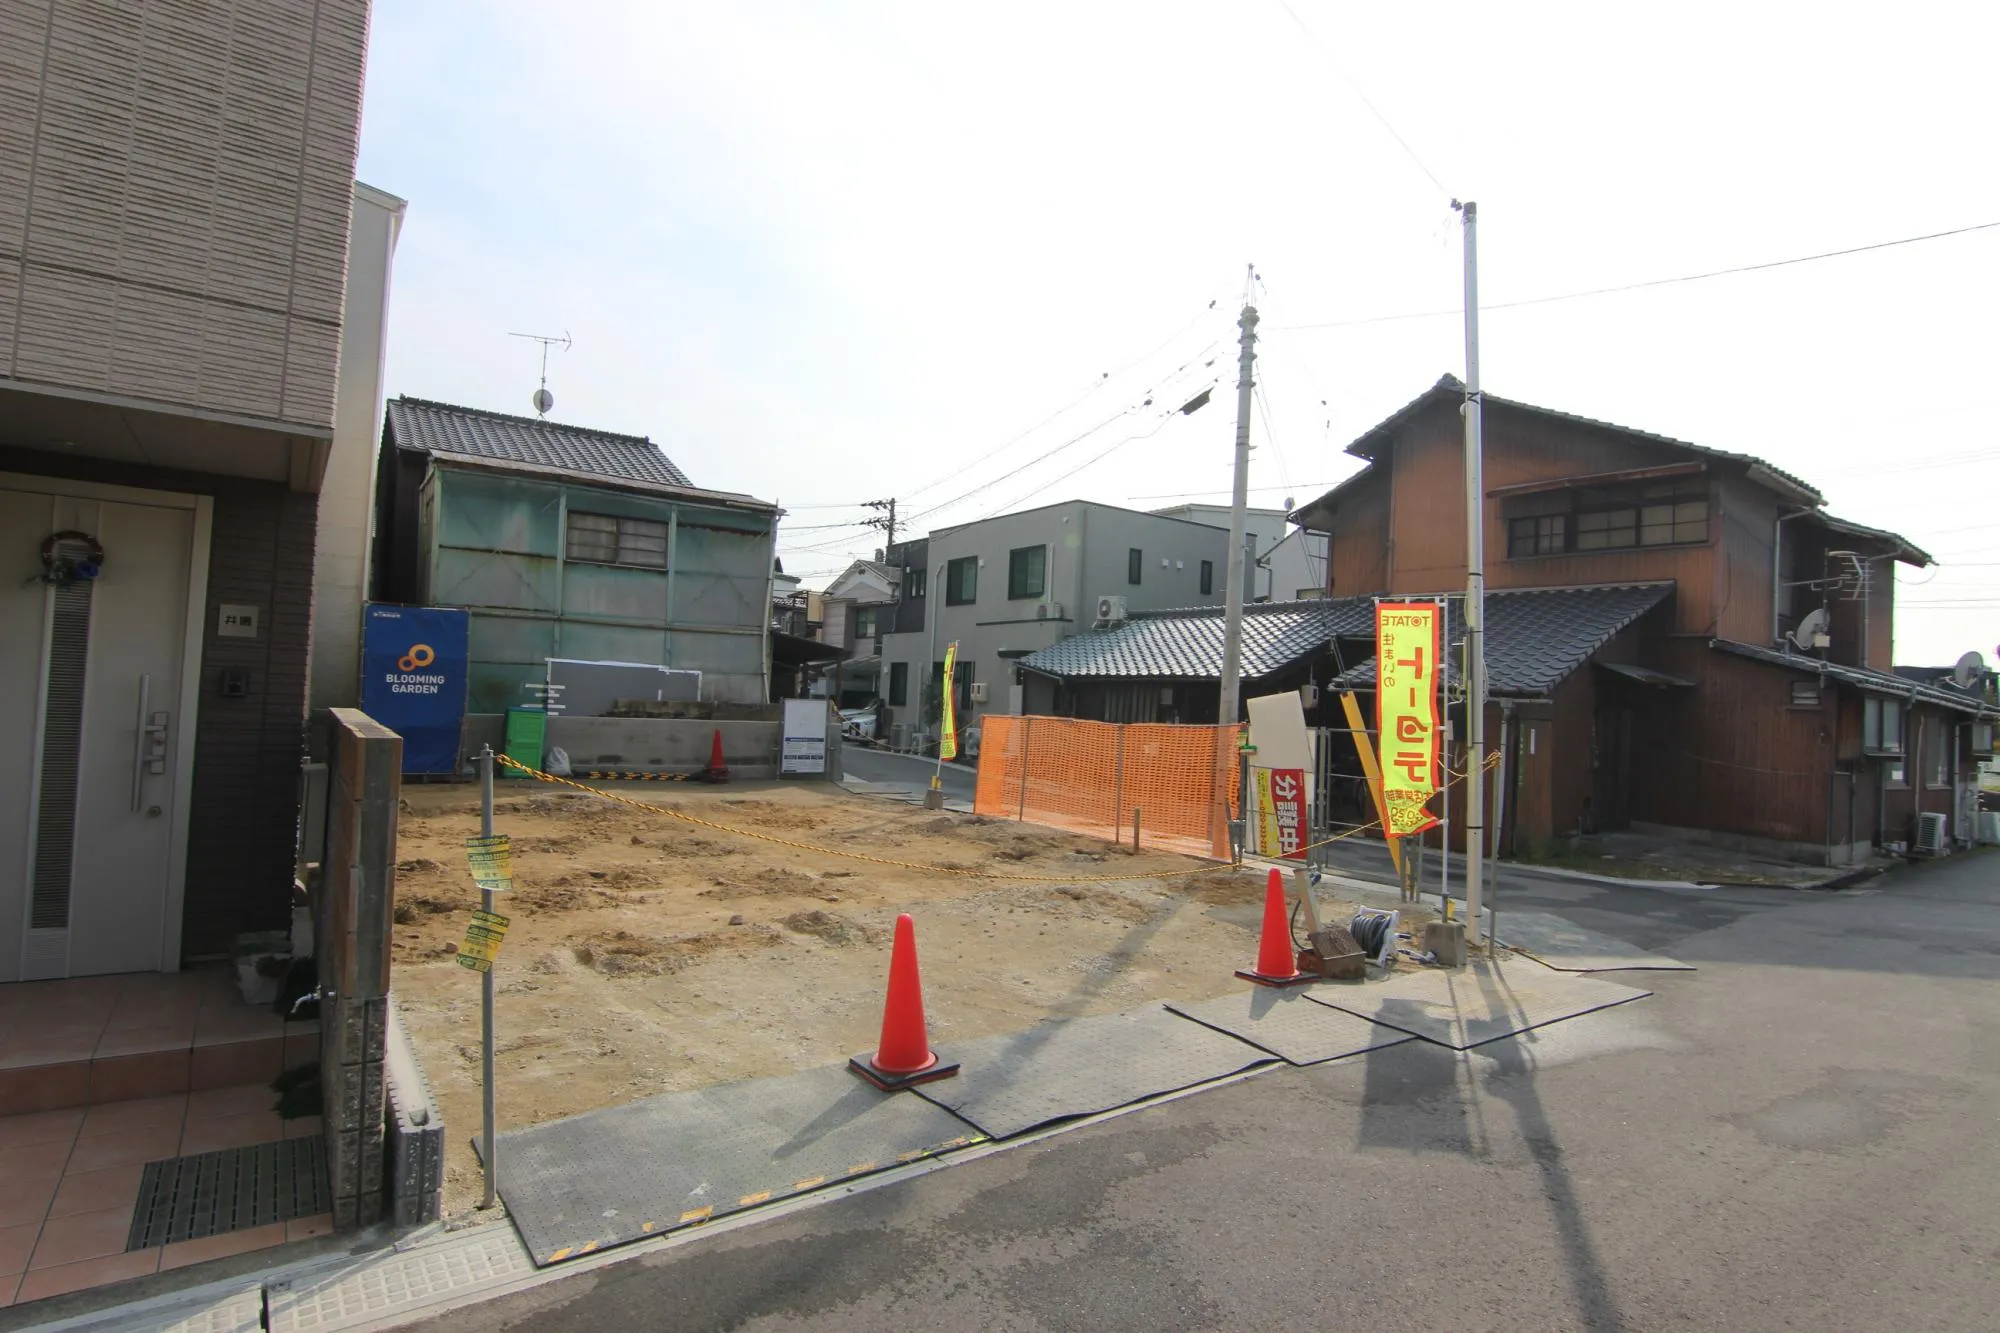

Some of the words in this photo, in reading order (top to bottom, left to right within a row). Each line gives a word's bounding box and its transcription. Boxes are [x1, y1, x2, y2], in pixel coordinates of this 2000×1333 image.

[386, 674, 445, 684] BLOOMING
[392, 685, 438, 694] GARDEN
[1275, 774, 1300, 852] 分譲中
